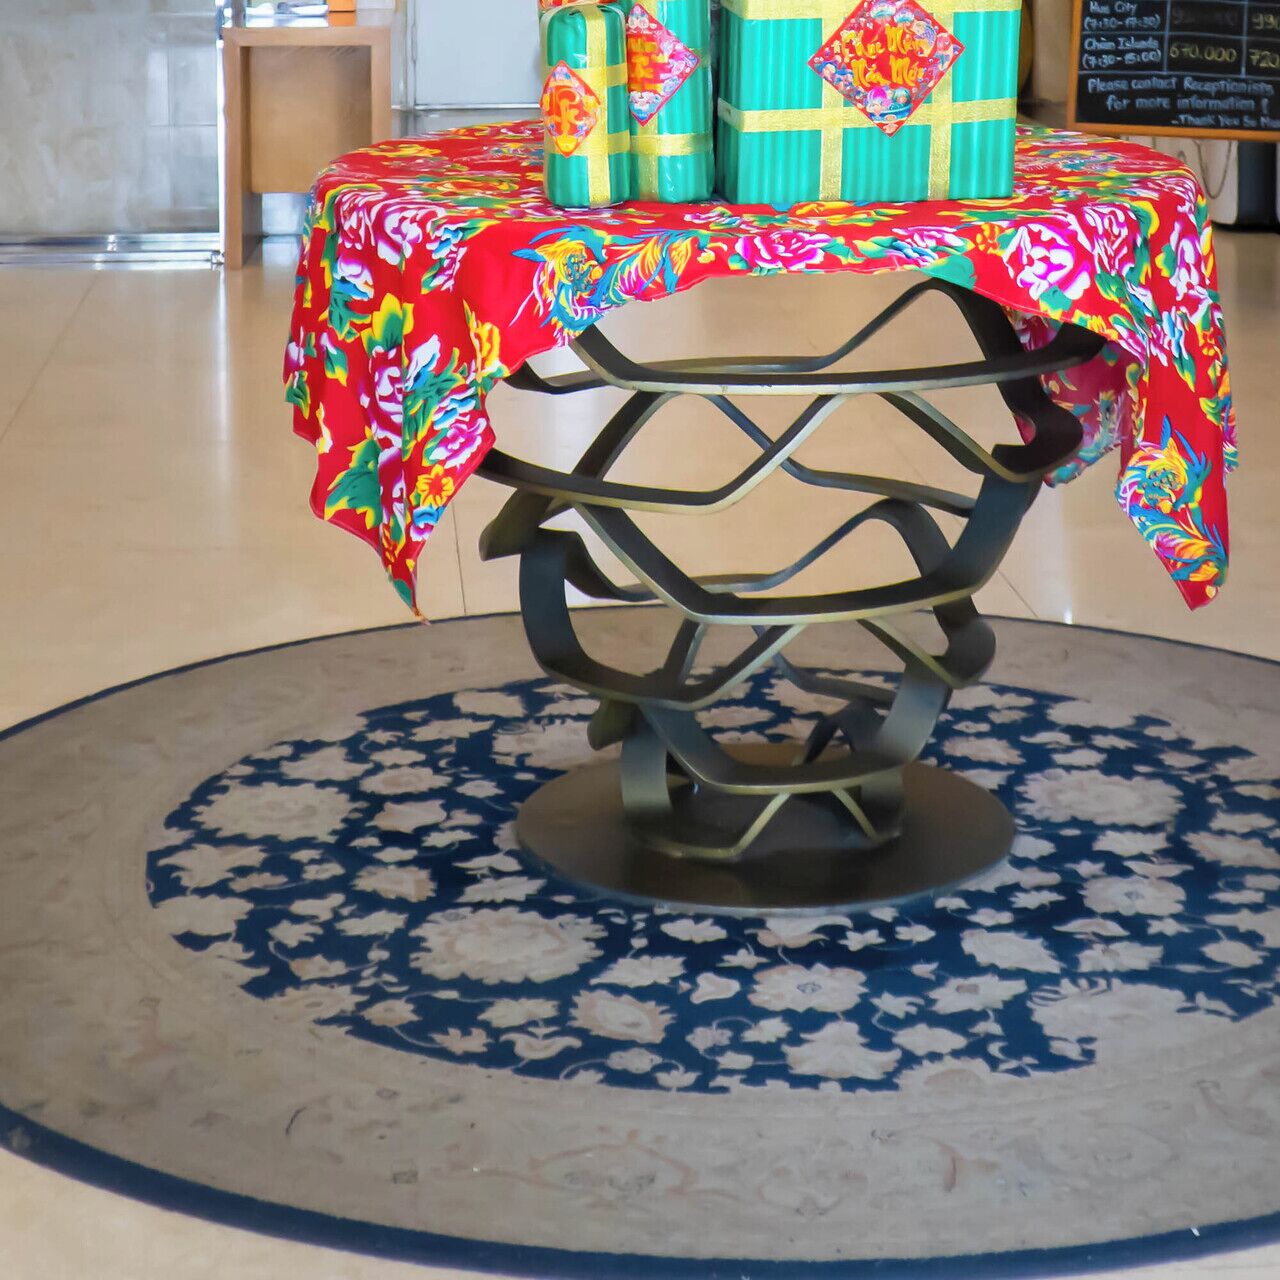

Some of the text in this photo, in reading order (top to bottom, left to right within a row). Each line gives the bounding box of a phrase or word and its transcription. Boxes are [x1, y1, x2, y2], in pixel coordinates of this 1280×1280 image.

[1087, 77, 1129, 94] Please
[1132, 76, 1177, 91] contact
[1106, 94, 1129, 111] for
[1135, 96, 1170, 109] more
[1177, 94, 1255, 110] information
